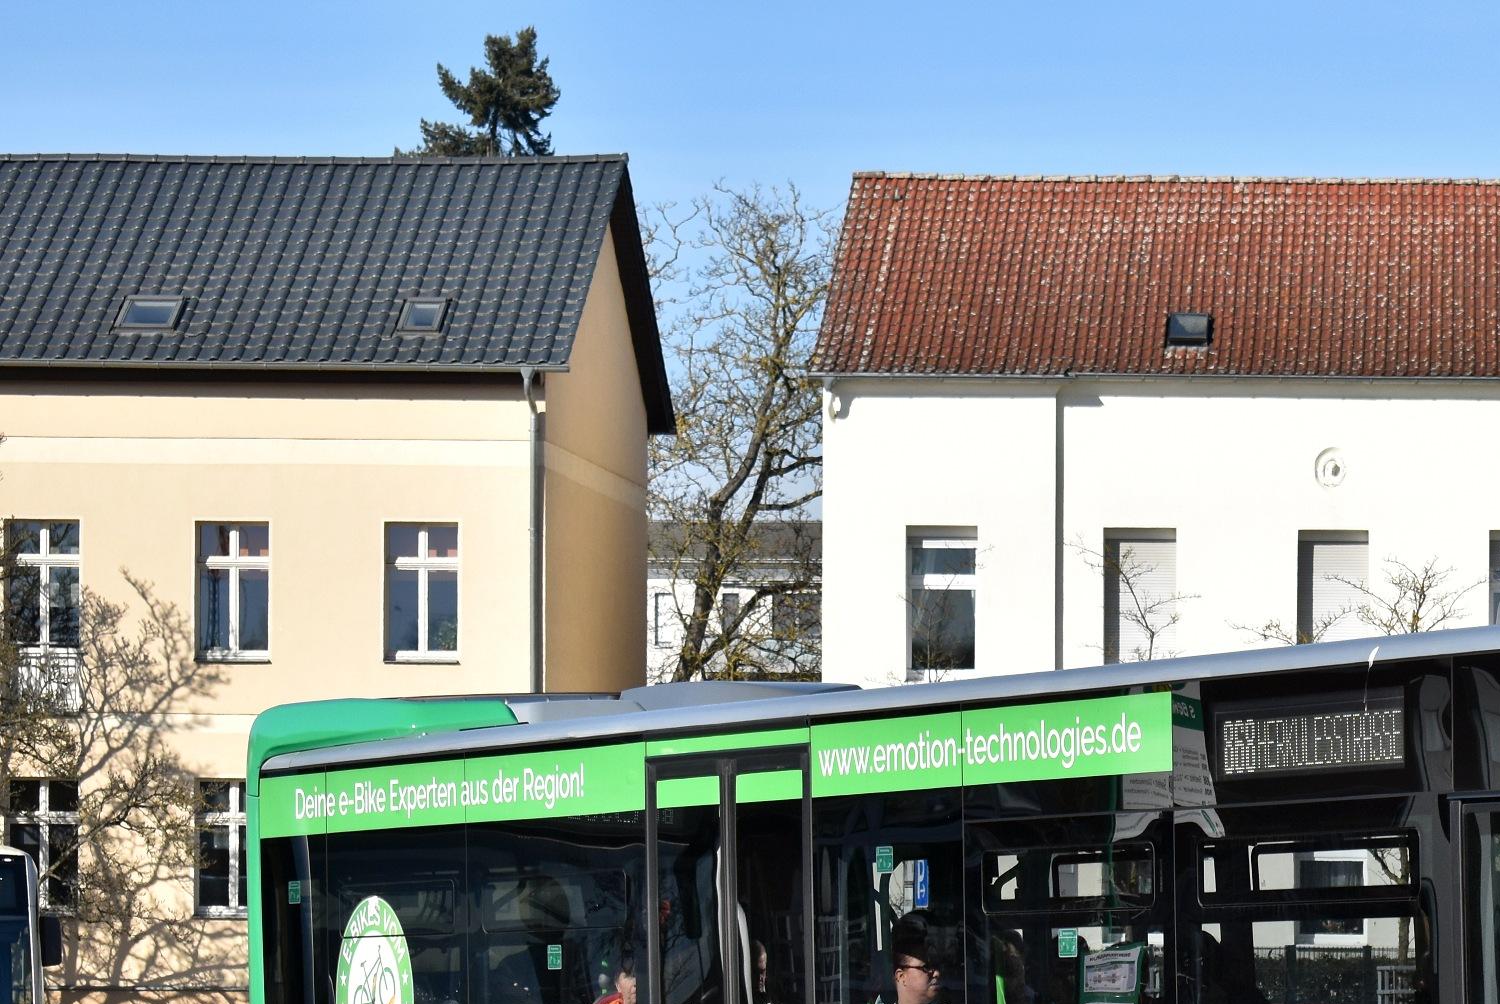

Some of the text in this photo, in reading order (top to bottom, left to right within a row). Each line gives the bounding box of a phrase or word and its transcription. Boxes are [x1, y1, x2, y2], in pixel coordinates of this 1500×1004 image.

[818, 711, 1142, 777] www.emotion-technologies.de
[295, 763, 585, 820] Deine e-Bike Experten aus der Region!
[383, 912, 406, 962] VOM
